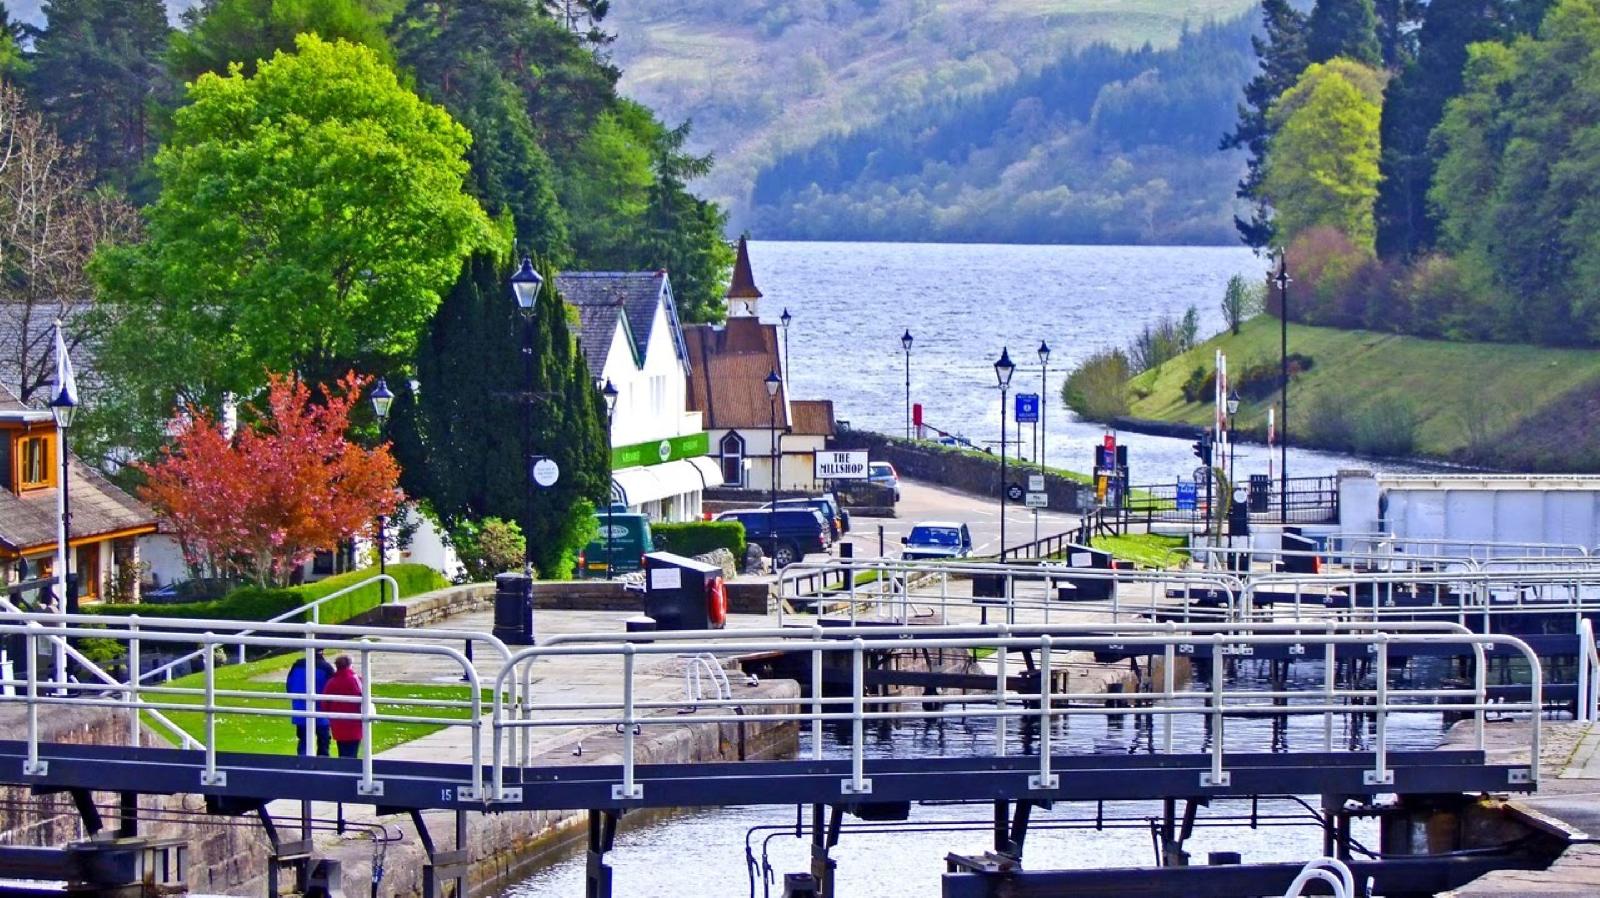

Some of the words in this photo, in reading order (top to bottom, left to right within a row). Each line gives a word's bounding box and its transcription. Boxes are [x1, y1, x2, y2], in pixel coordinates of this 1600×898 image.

[833, 452, 850, 463] THE
[820, 463, 864, 474] MILLSHOP
[441, 789, 452, 800] 15
